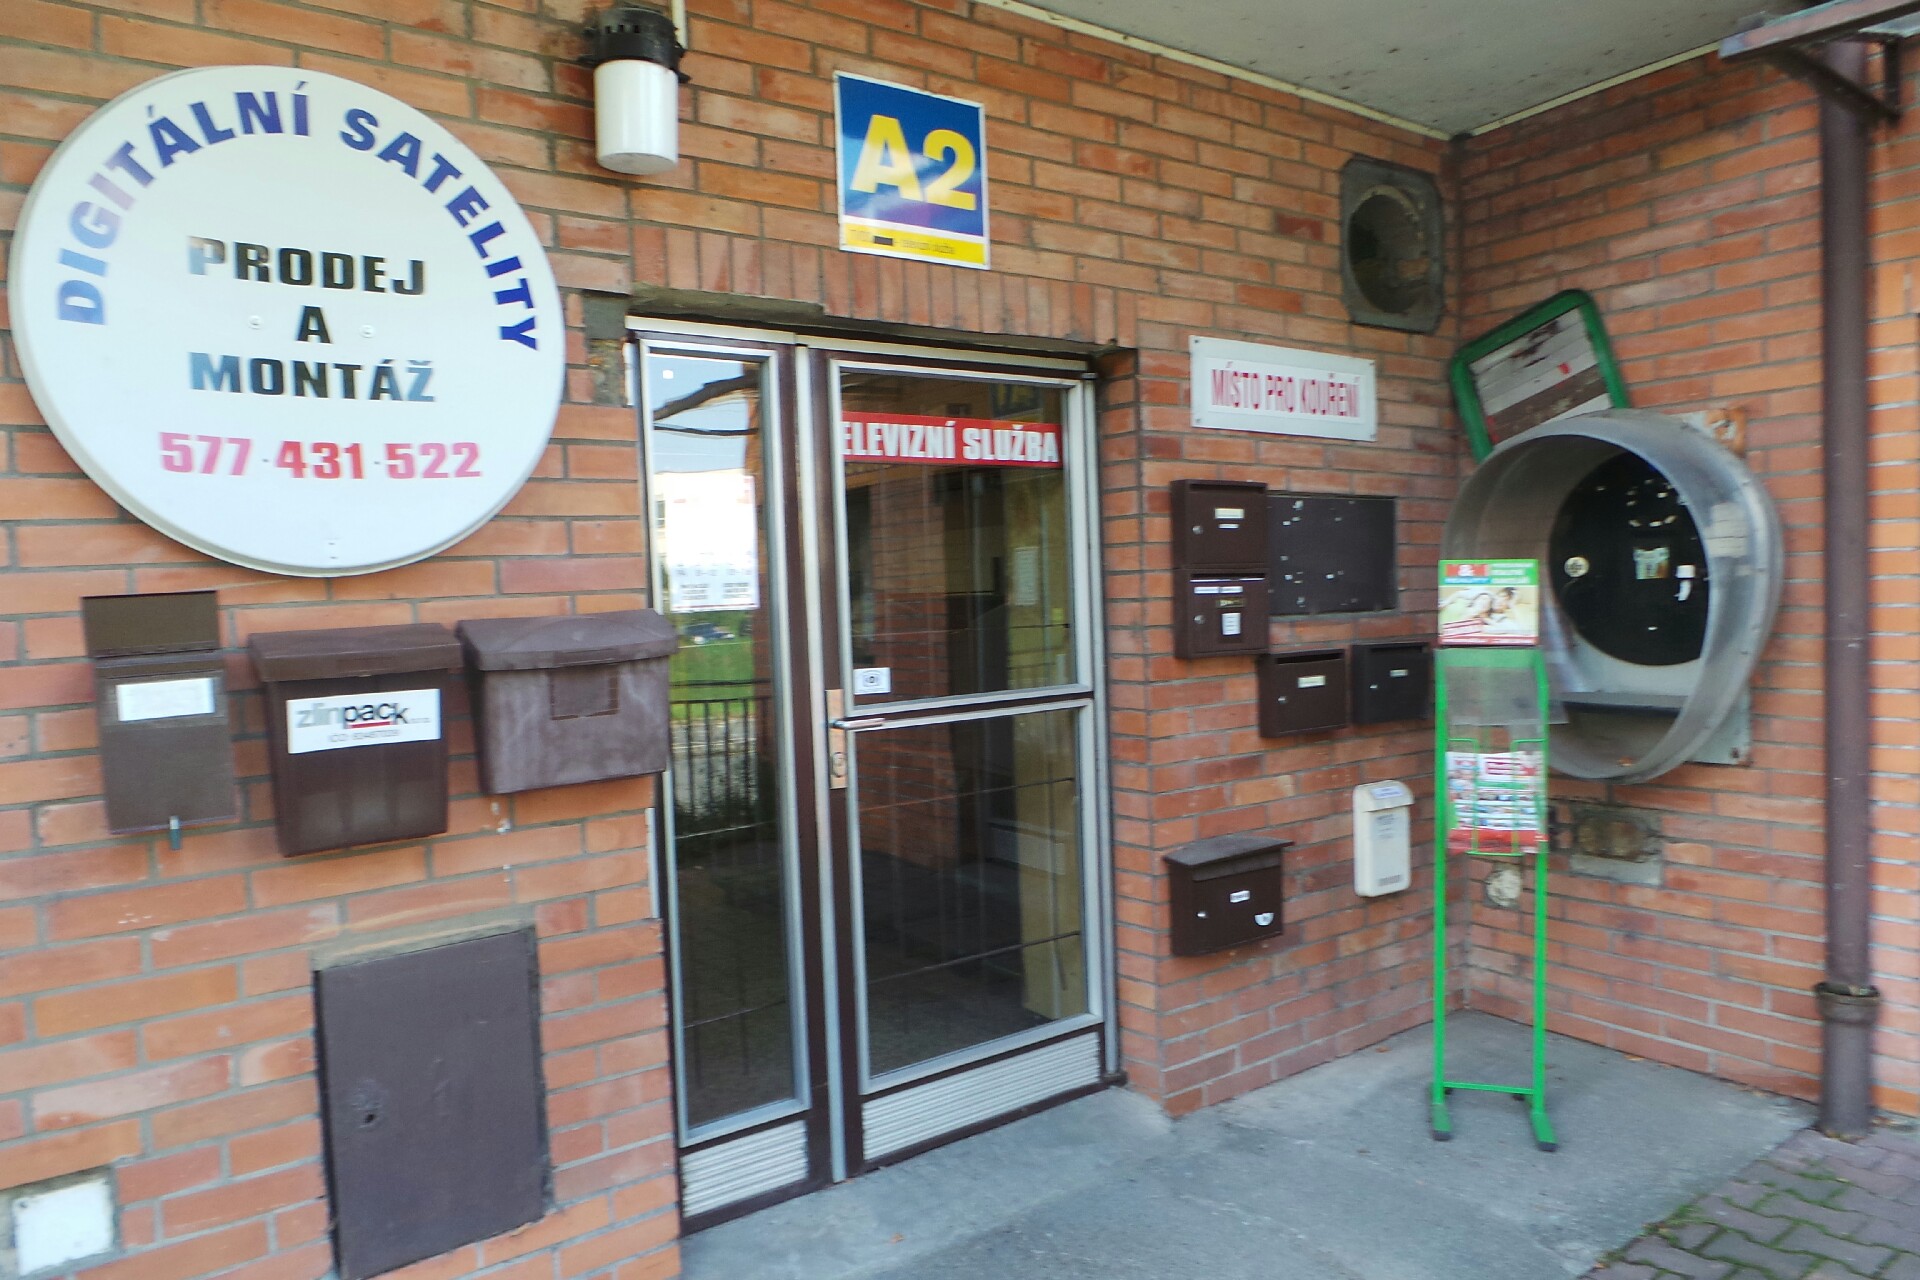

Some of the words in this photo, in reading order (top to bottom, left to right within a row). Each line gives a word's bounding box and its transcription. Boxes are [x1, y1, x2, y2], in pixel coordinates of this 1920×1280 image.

[850, 114, 977, 211] A2
[57, 82, 311, 325] DIGITÁLNÍ
[339, 108, 538, 351] SATELITY
[188, 235, 424, 295] PRODEJ
[296, 304, 333, 344] A
[189, 352, 436, 402] MONTÁŽ
[1211, 361, 1261, 410] MÍSTO
[1265, 375, 1296, 413] PRO
[1299, 372, 1361, 418] KOUŘENÍ
[962, 424, 1059, 463] SLUŽBA
